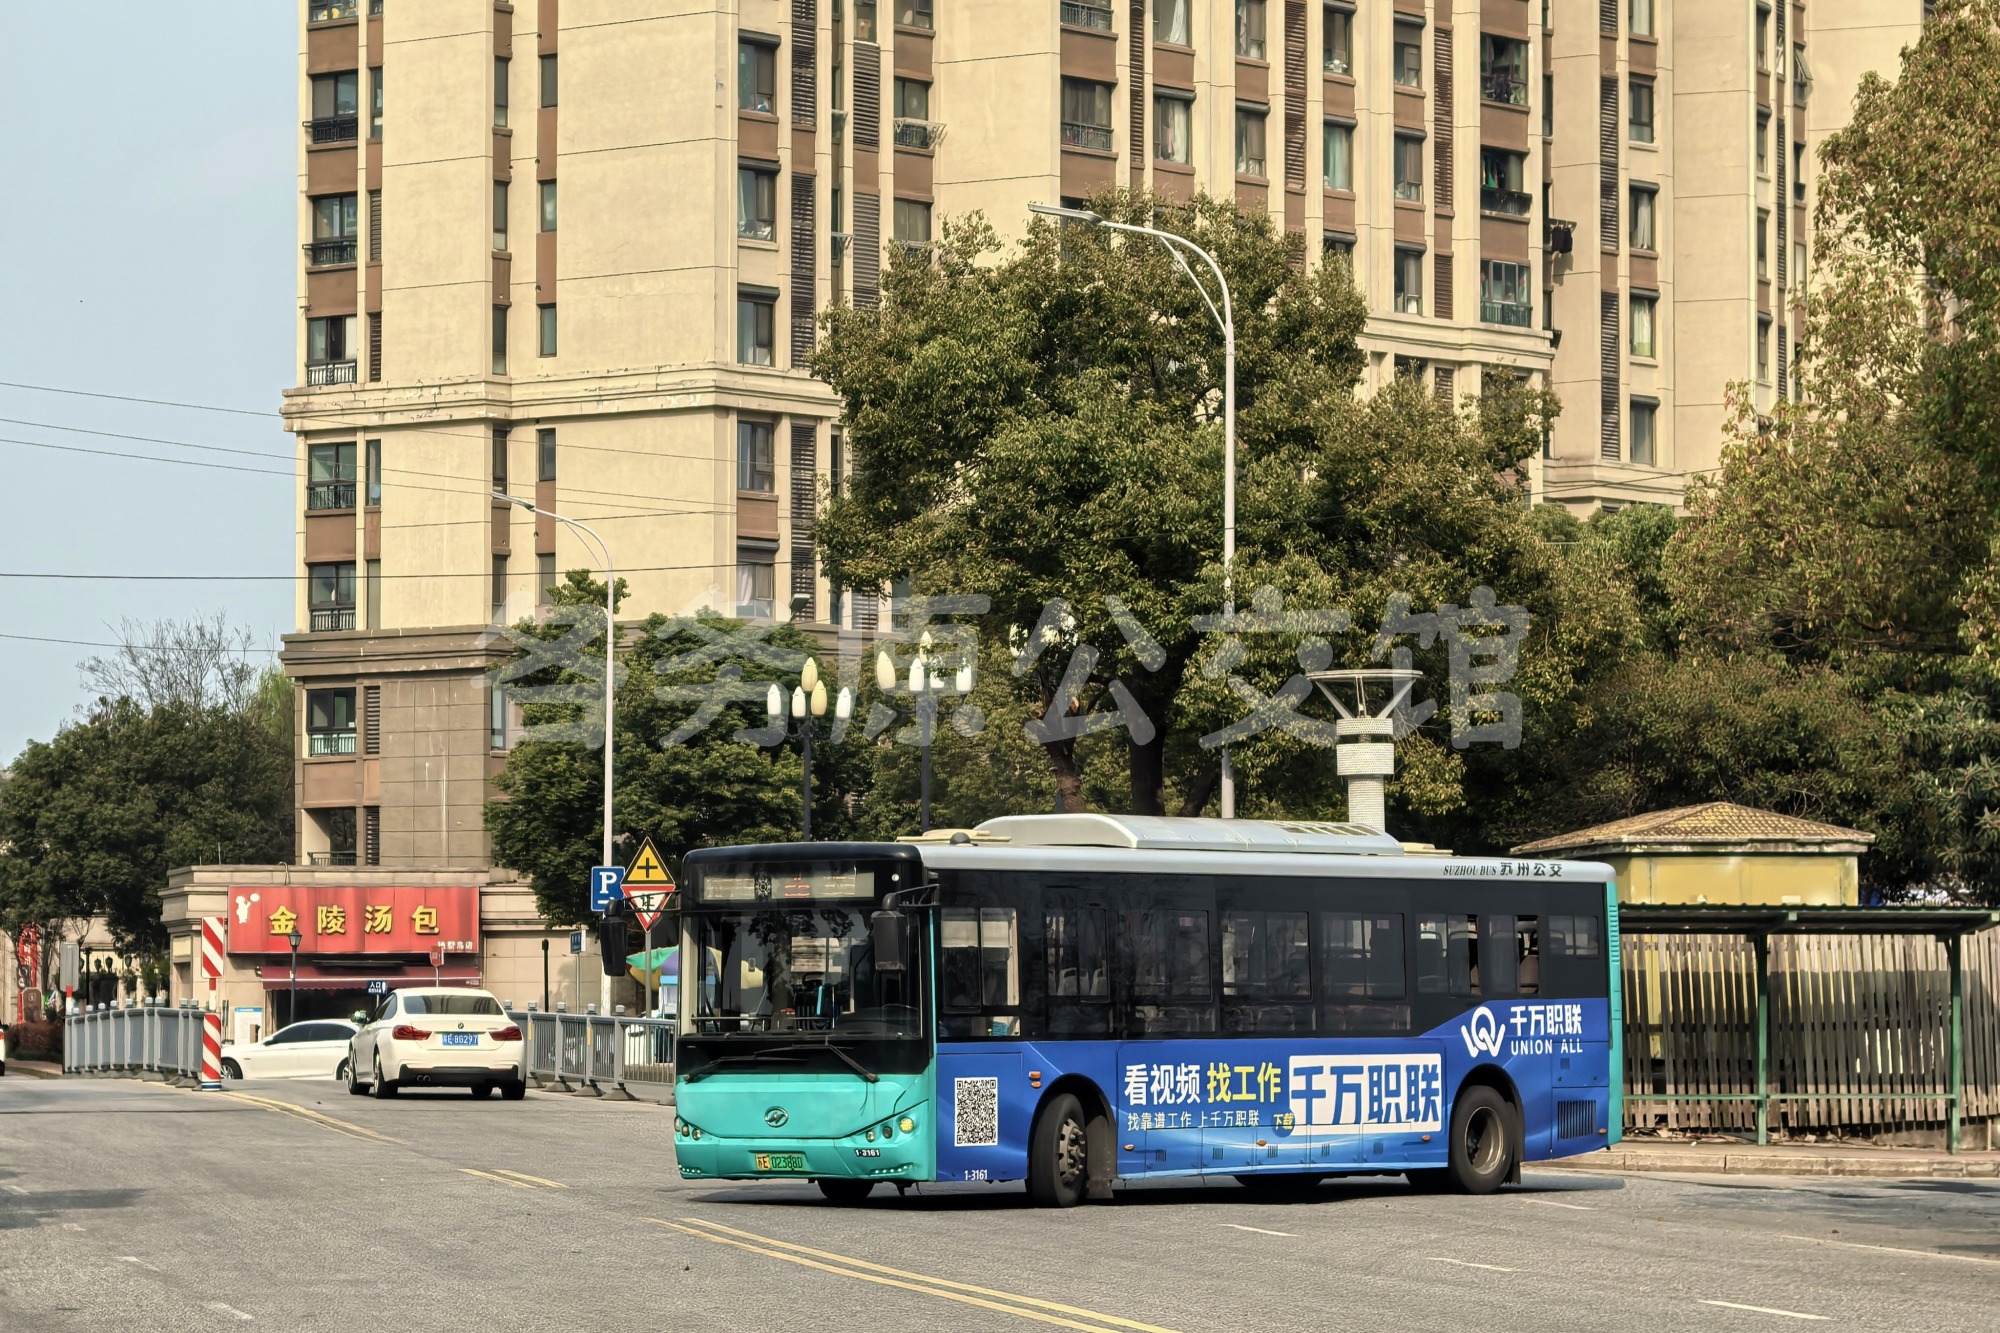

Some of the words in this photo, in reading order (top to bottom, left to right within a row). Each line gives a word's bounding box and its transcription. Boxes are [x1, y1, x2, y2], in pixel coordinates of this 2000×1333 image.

[1443, 864, 1478, 876] SUZHOU
[1480, 864, 1498, 876] BUS
[1500, 861, 1563, 878] 苏州公交
[599, 871, 617, 894] P
[269, 905, 440, 935] 金陵汤包
[1509, 1004, 1582, 1037] 千万职联
[1510, 1039, 1553, 1056] UNION
[1560, 1038, 1583, 1054] ALL
[1124, 1063, 1200, 1106] 看视频
[1207, 1062, 1281, 1103] 找工作
[1291, 1064, 1440, 1126] 千万职联
[1127, 1110, 1192, 1132] 找靠谱工作
[1197, 1109, 1260, 1129] 上千万职联
[1272, 1112, 1294, 1131] 下载
[964, 1169, 988, 1181] 1-3161
